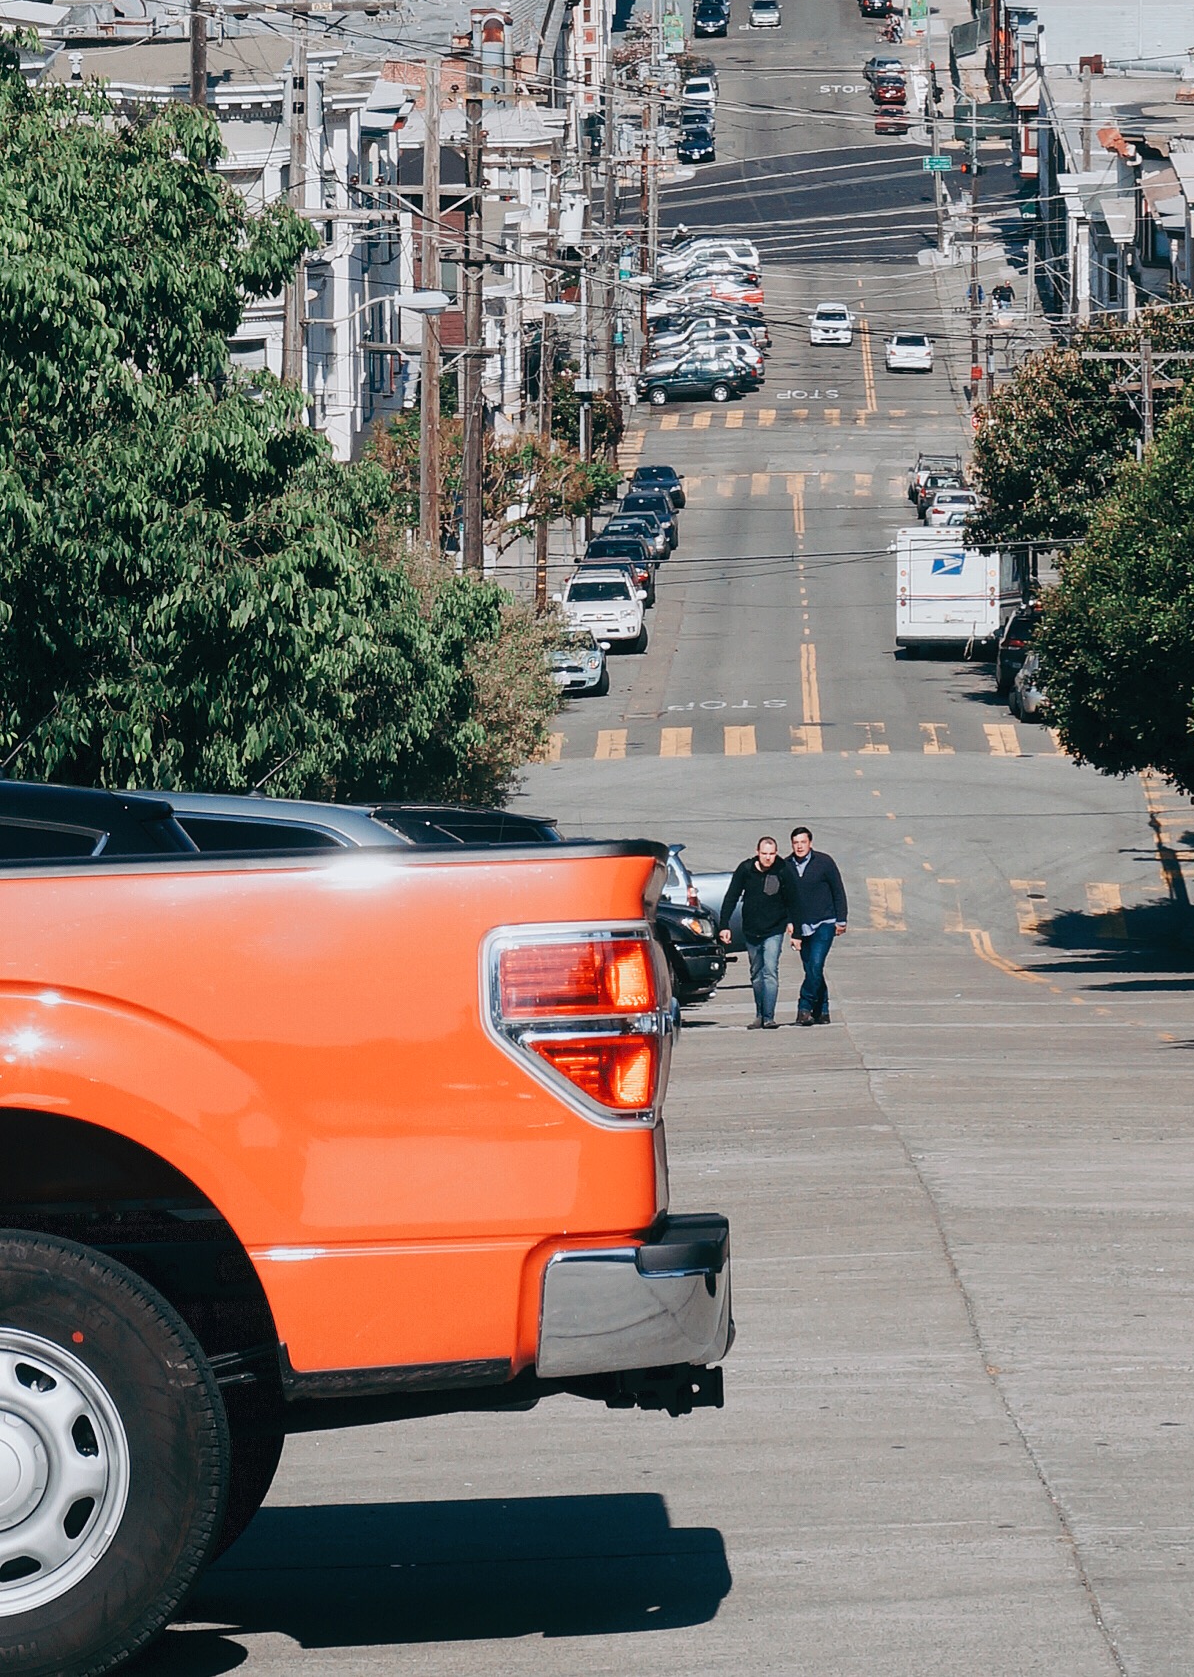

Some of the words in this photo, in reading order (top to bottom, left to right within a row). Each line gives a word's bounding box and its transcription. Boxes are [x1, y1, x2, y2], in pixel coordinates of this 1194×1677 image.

[820, 85, 866, 93] STOP
[777, 389, 839, 400] STOP
[668, 699, 787, 711] STOP
